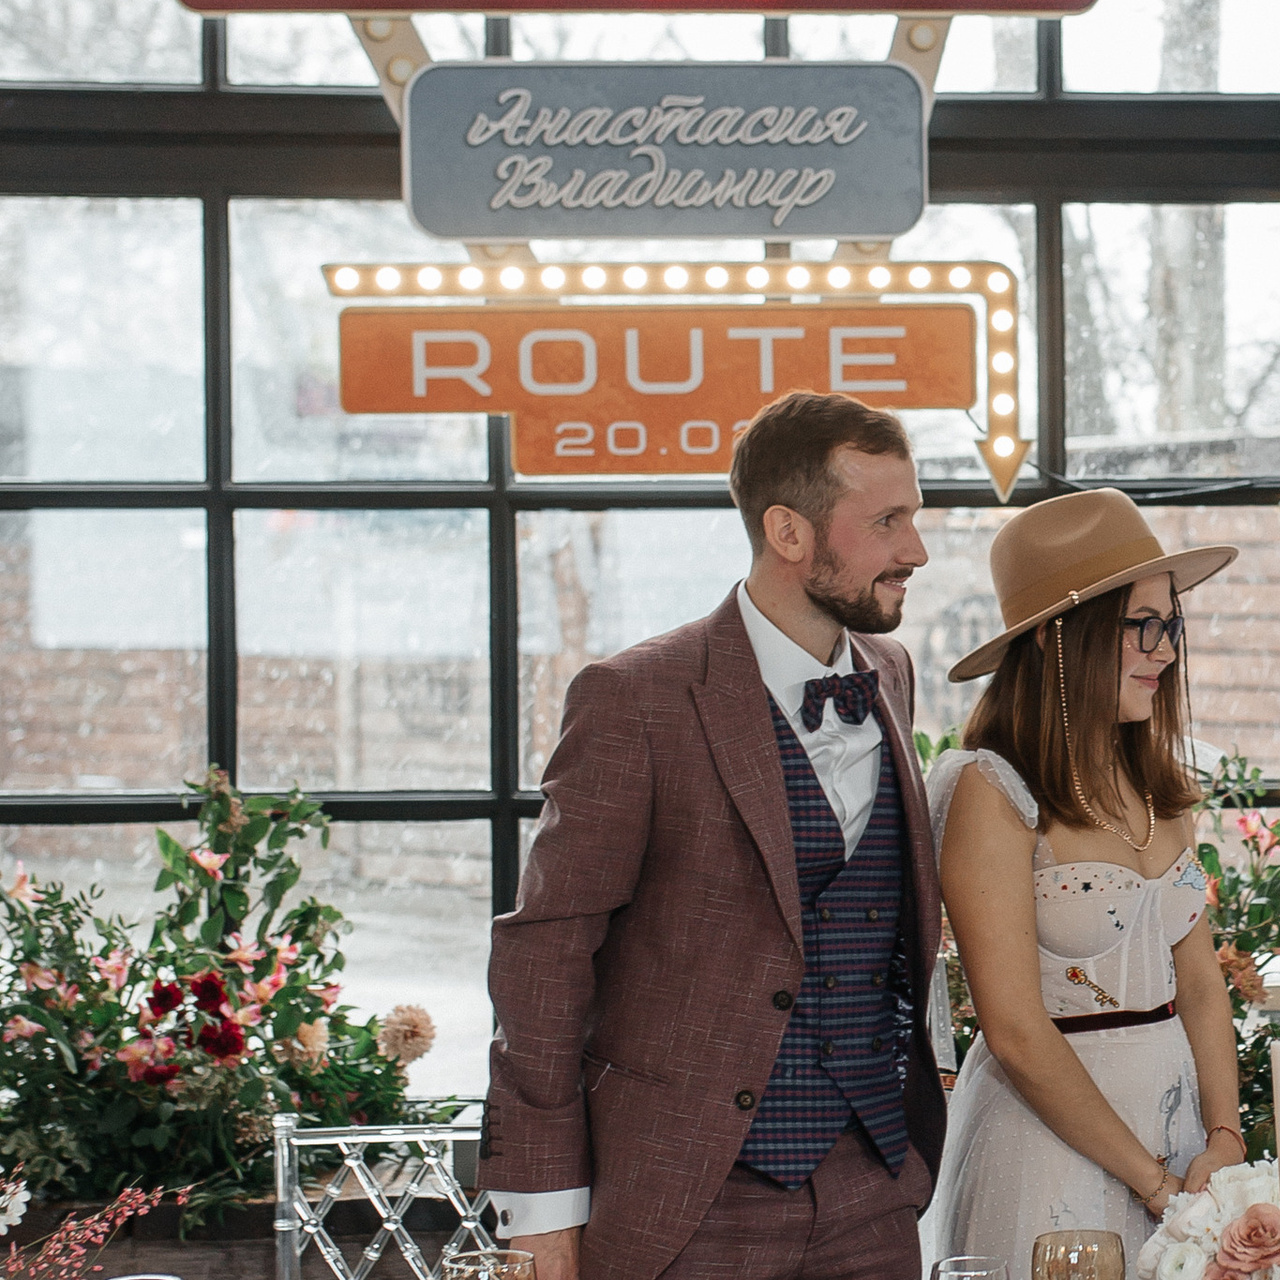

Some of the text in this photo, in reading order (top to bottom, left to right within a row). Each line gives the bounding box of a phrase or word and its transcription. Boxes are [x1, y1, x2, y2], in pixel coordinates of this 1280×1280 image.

[466, 88, 868, 146] Анастасия
[490, 144, 837, 227] Владимир
[411, 326, 909, 398] ROUTE
